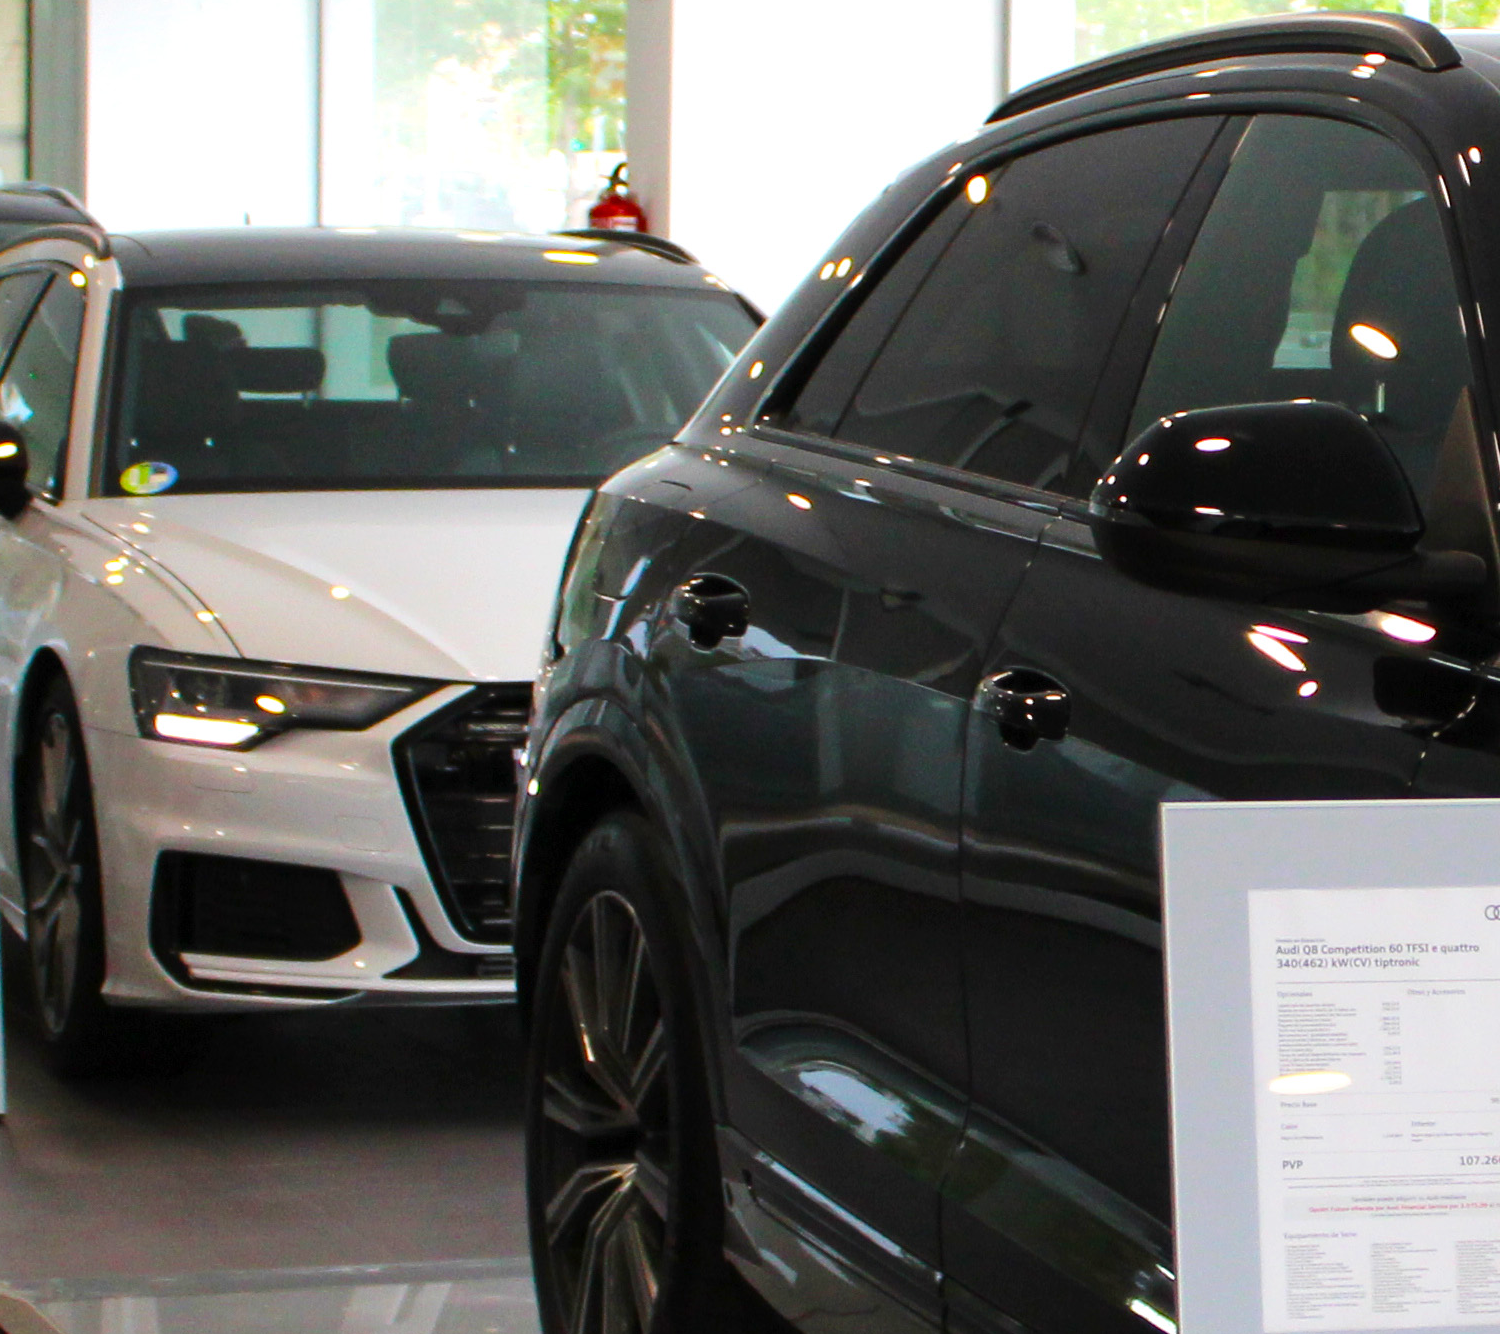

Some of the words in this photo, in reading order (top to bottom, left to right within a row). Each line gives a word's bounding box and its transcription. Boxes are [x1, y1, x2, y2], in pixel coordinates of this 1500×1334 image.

[1276, 945, 1300, 956] Audi
[1321, 943, 1386, 956] Competition
[1389, 943, 1404, 954] 60
[1406, 943, 1430, 954] TFSI
[1440, 943, 1480, 955] quattro
[1276, 957, 1328, 969] 340(462)
[1331, 957, 1372, 969] kW(CV)
[1375, 956, 1420, 968] tiptronic
[1282, 1160, 1303, 1170] PVP
